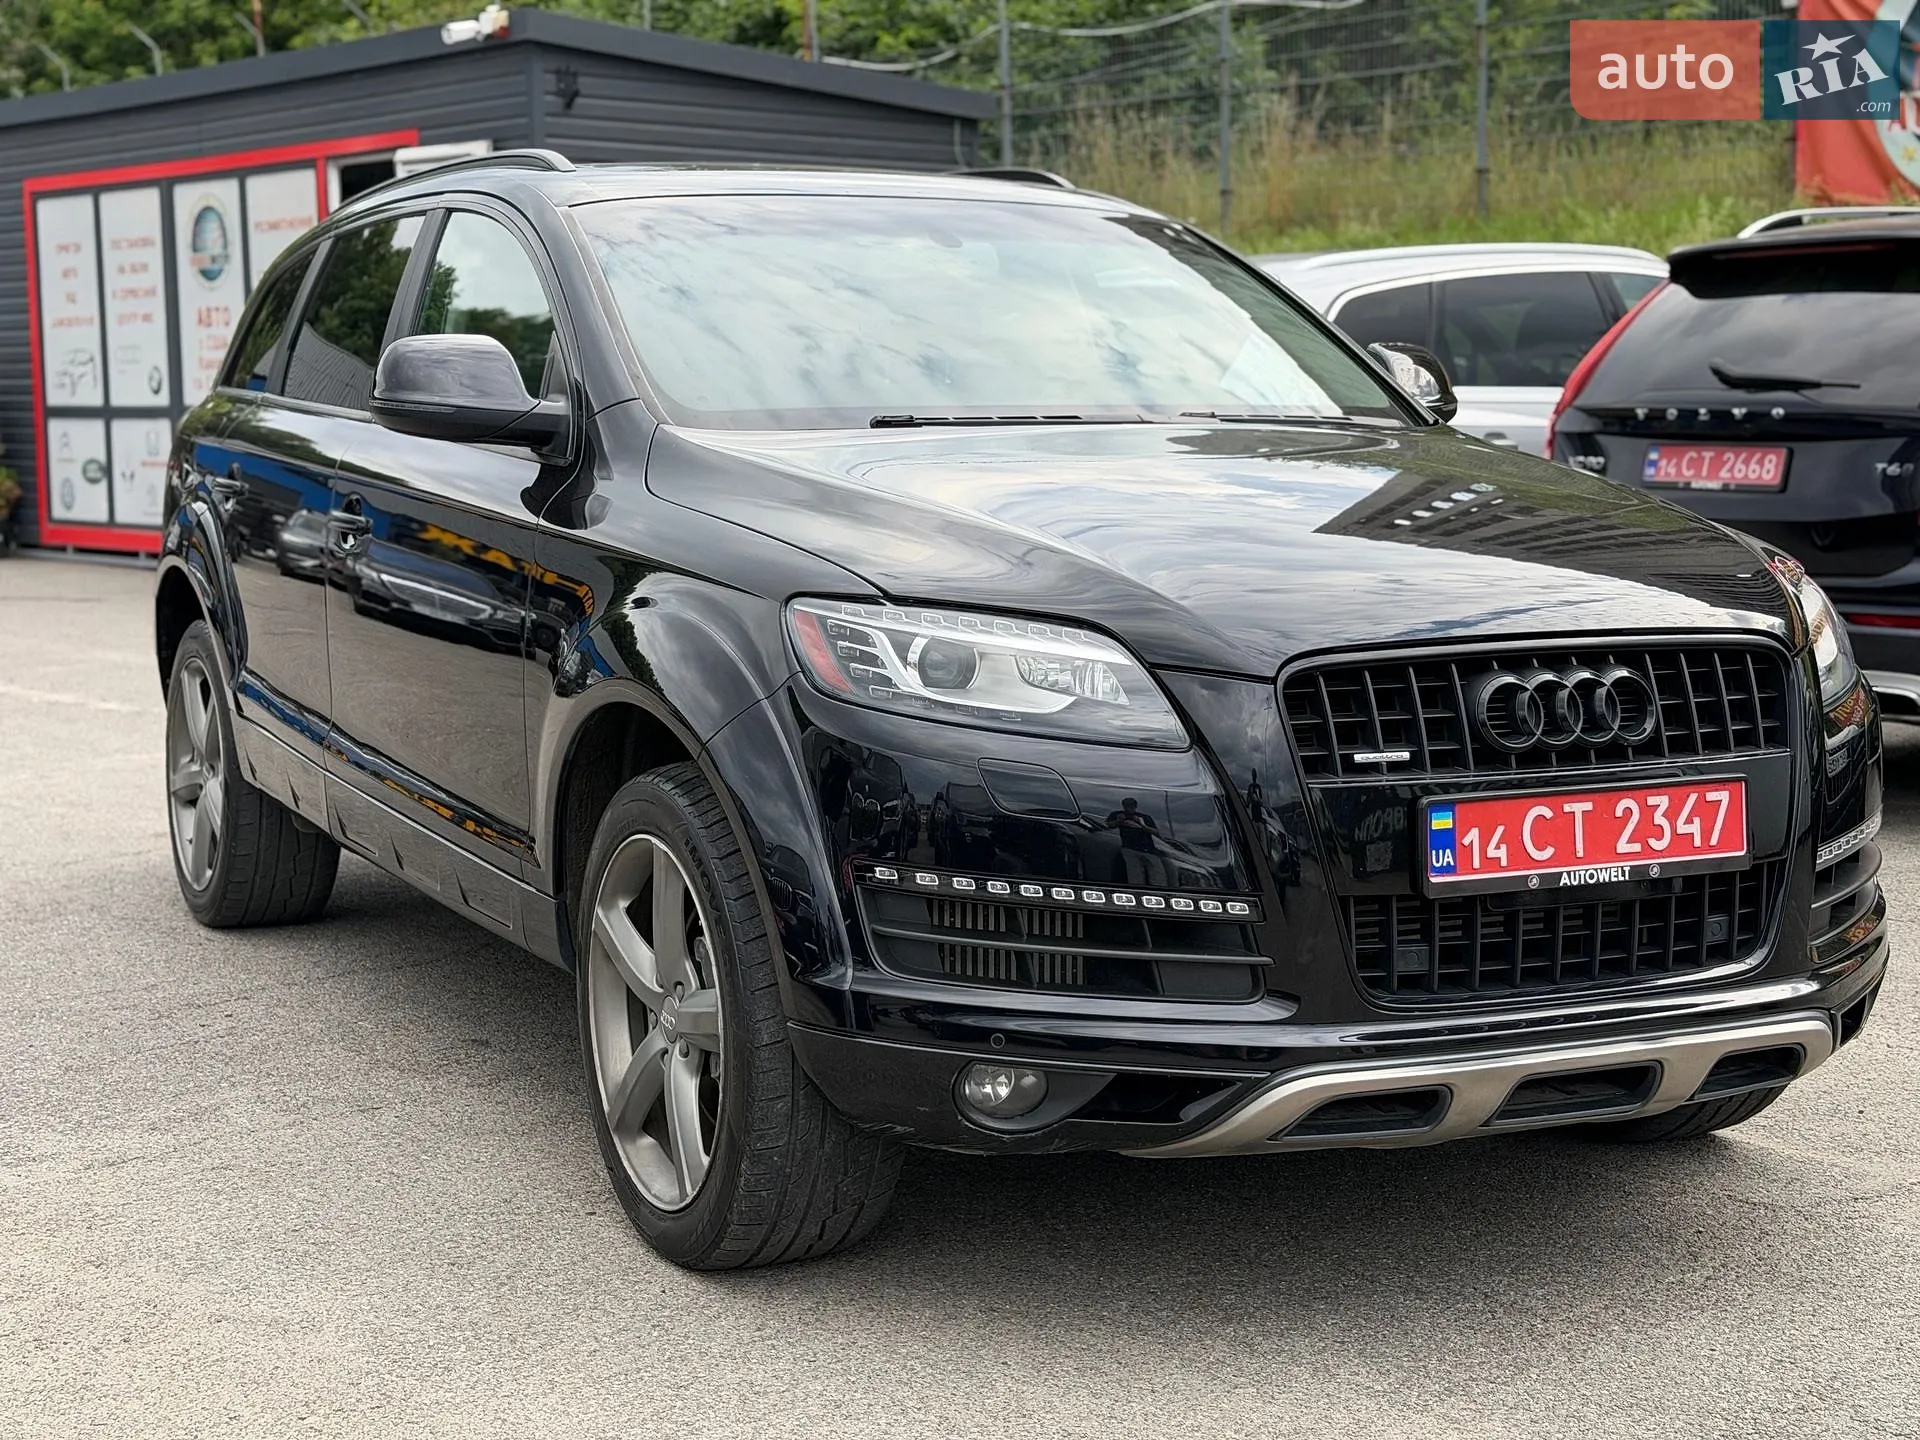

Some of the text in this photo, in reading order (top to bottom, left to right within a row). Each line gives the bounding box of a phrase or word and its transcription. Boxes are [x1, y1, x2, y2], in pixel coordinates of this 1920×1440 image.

[1635, 407, 1785, 421] VOLVO
[1658, 451, 1778, 480] 14 CT 2668
[1461, 790, 1730, 870] 14 CT 2347
[1432, 848, 1454, 868] UA
[1559, 866, 1631, 887] AUTOWELT
